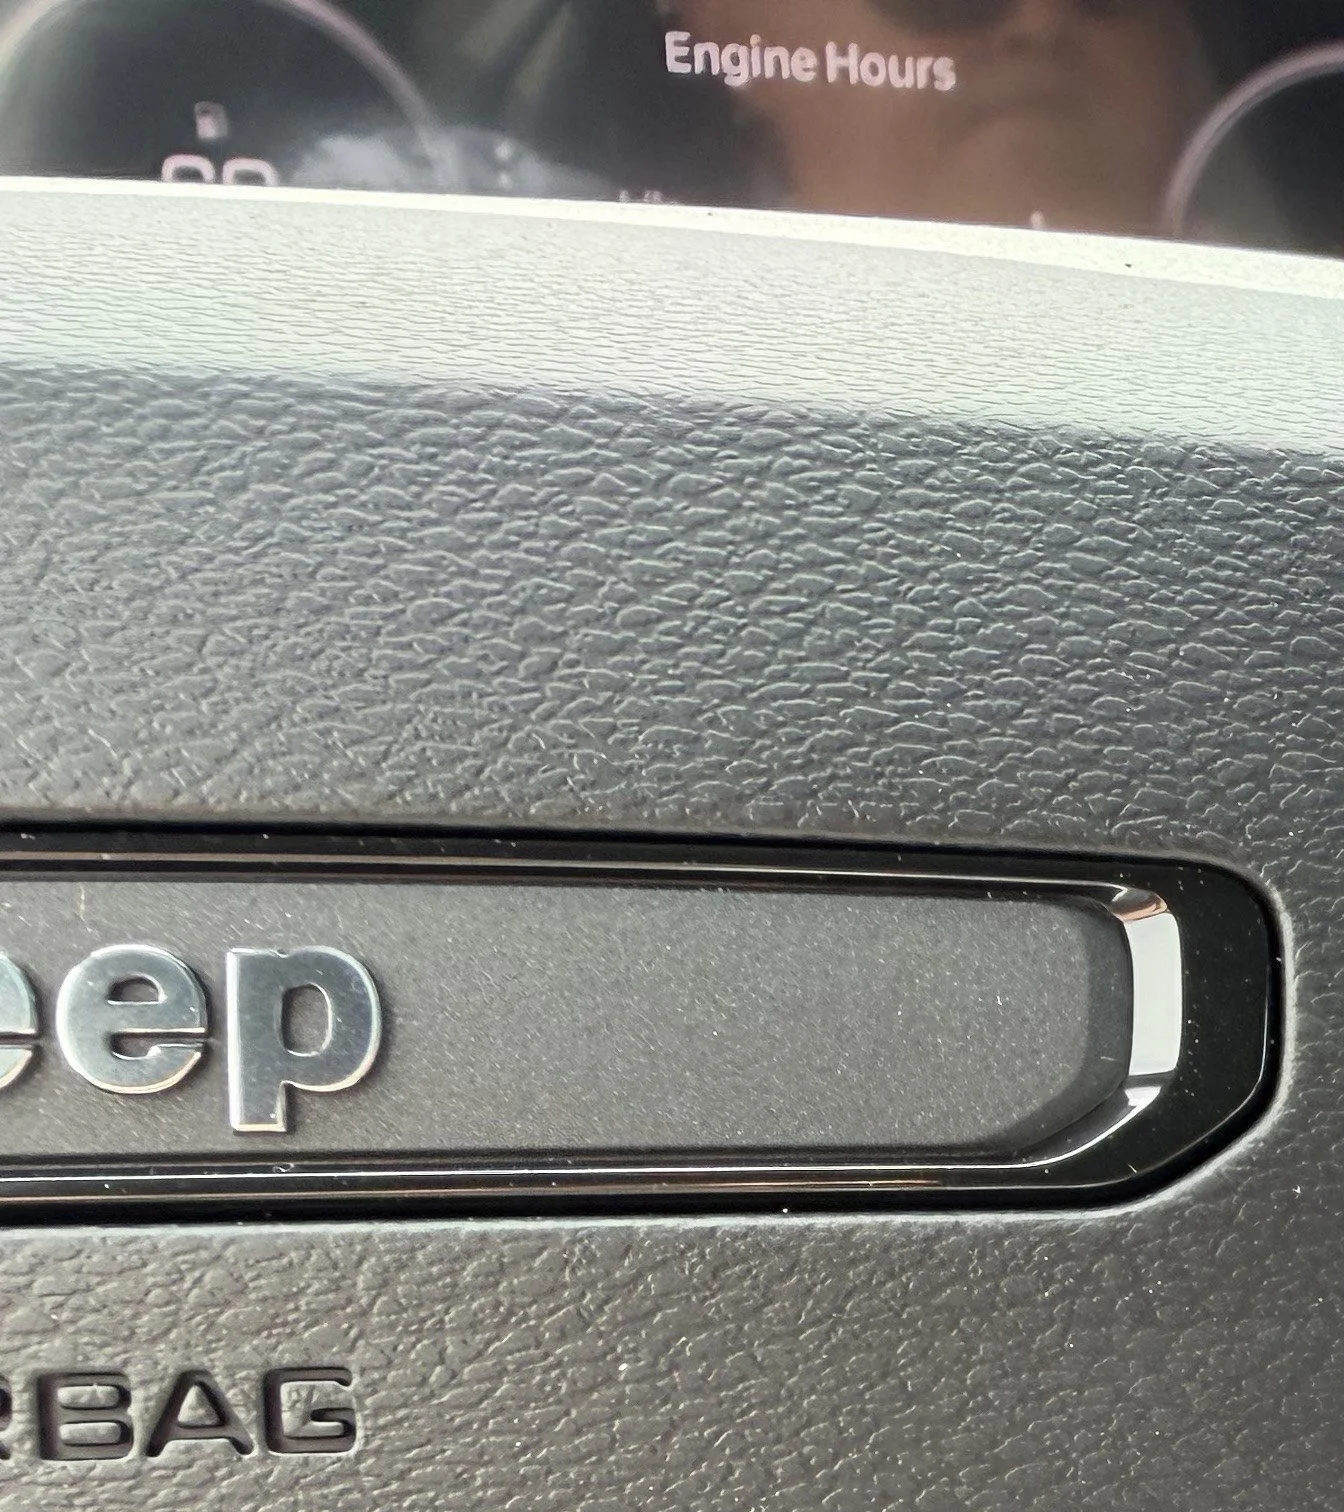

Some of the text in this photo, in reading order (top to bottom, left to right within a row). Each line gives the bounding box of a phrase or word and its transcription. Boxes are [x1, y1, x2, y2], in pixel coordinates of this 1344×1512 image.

[664, 30, 958, 92] Engine Hours
[0, 943, 382, 1133] ep
[0, 1366, 358, 1462] BAG
